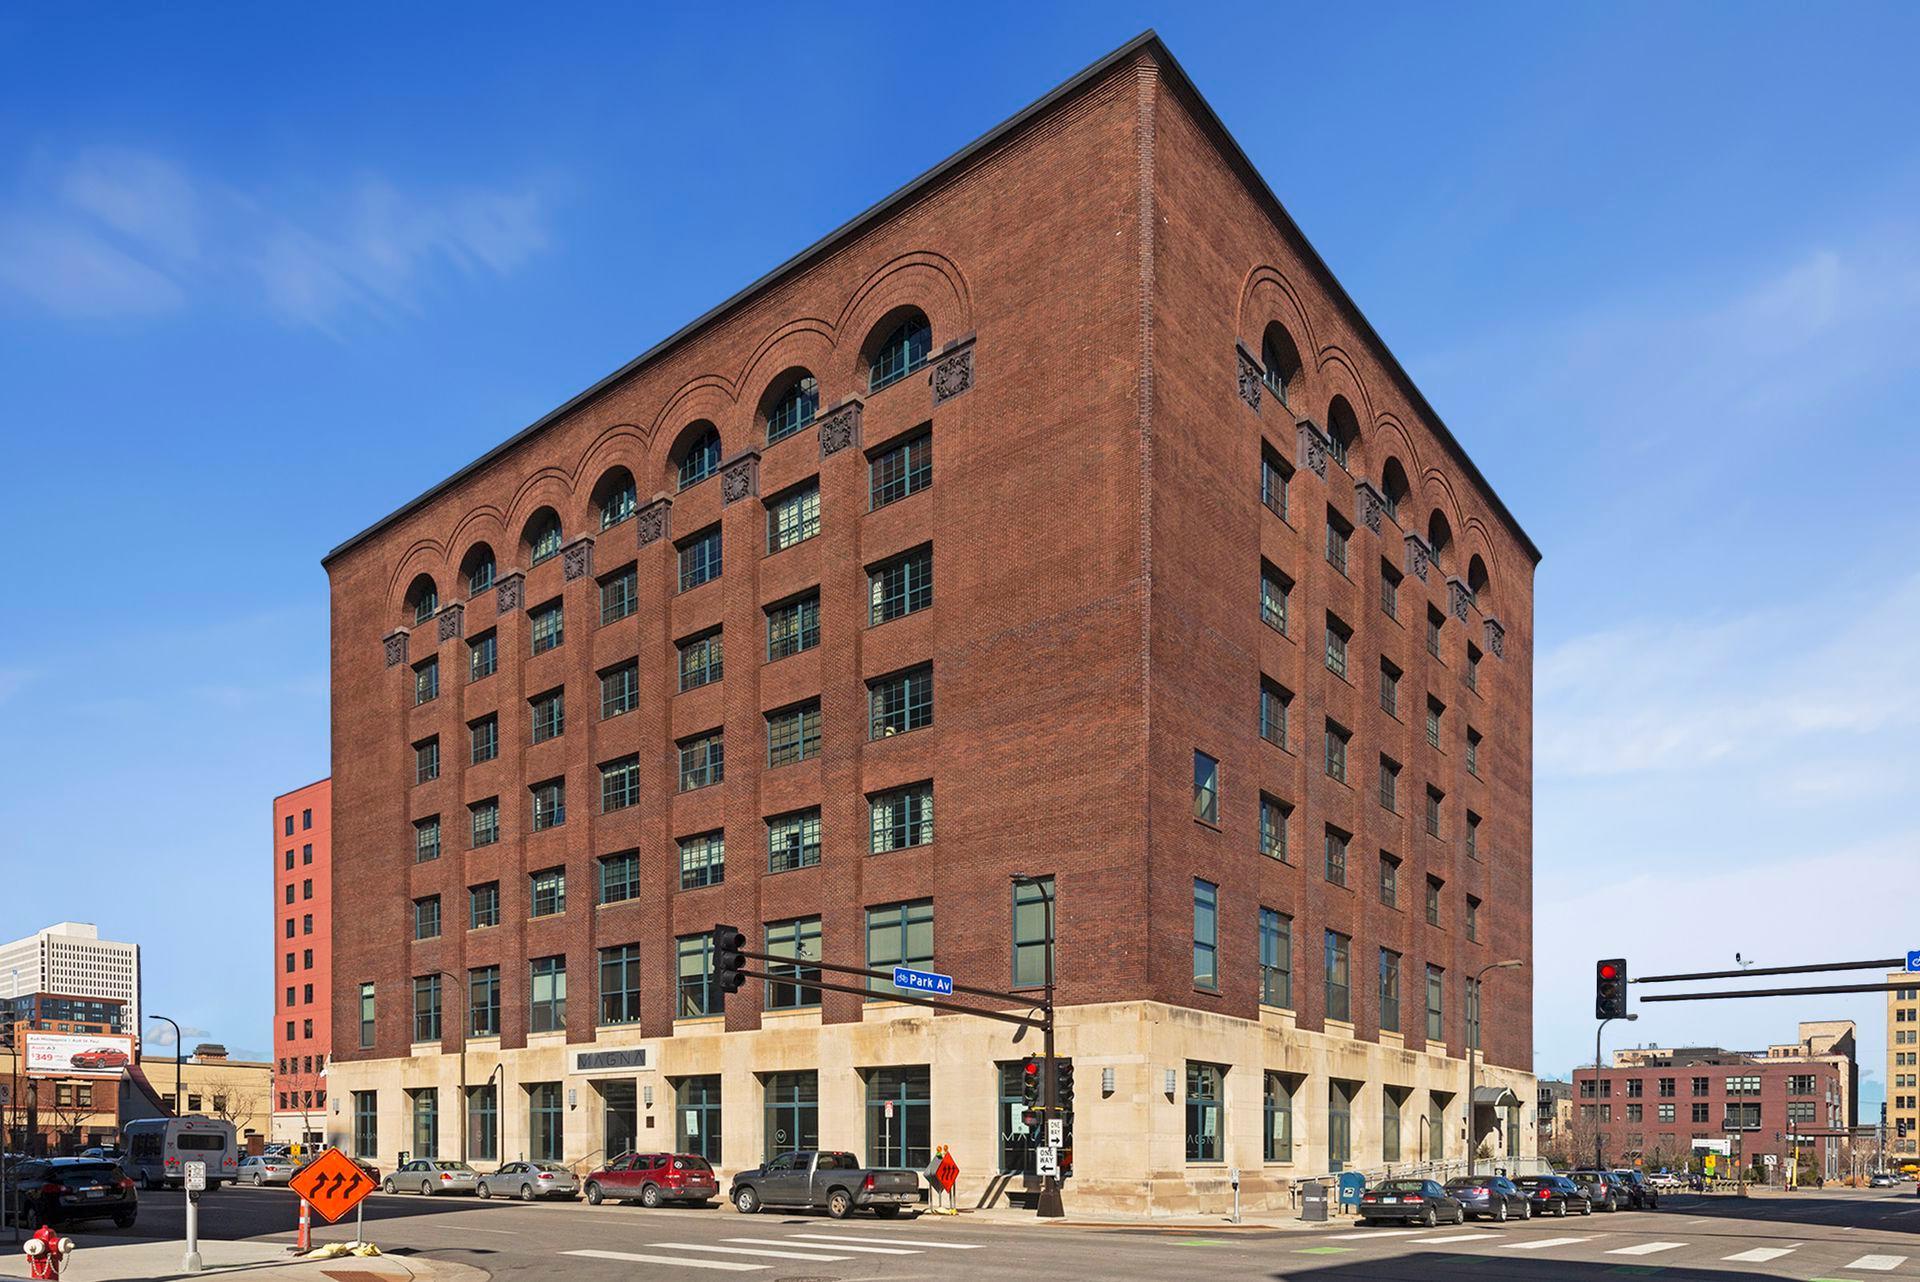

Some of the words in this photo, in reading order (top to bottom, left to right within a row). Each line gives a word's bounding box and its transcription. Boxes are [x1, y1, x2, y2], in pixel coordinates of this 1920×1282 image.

[910, 973, 933, 989] Park
[937, 978, 950, 991] Av
[579, 1051, 644, 1067] MAGNA
[1050, 1121, 1061, 1129] ONE
[1040, 1149, 1054, 1157] ONE
